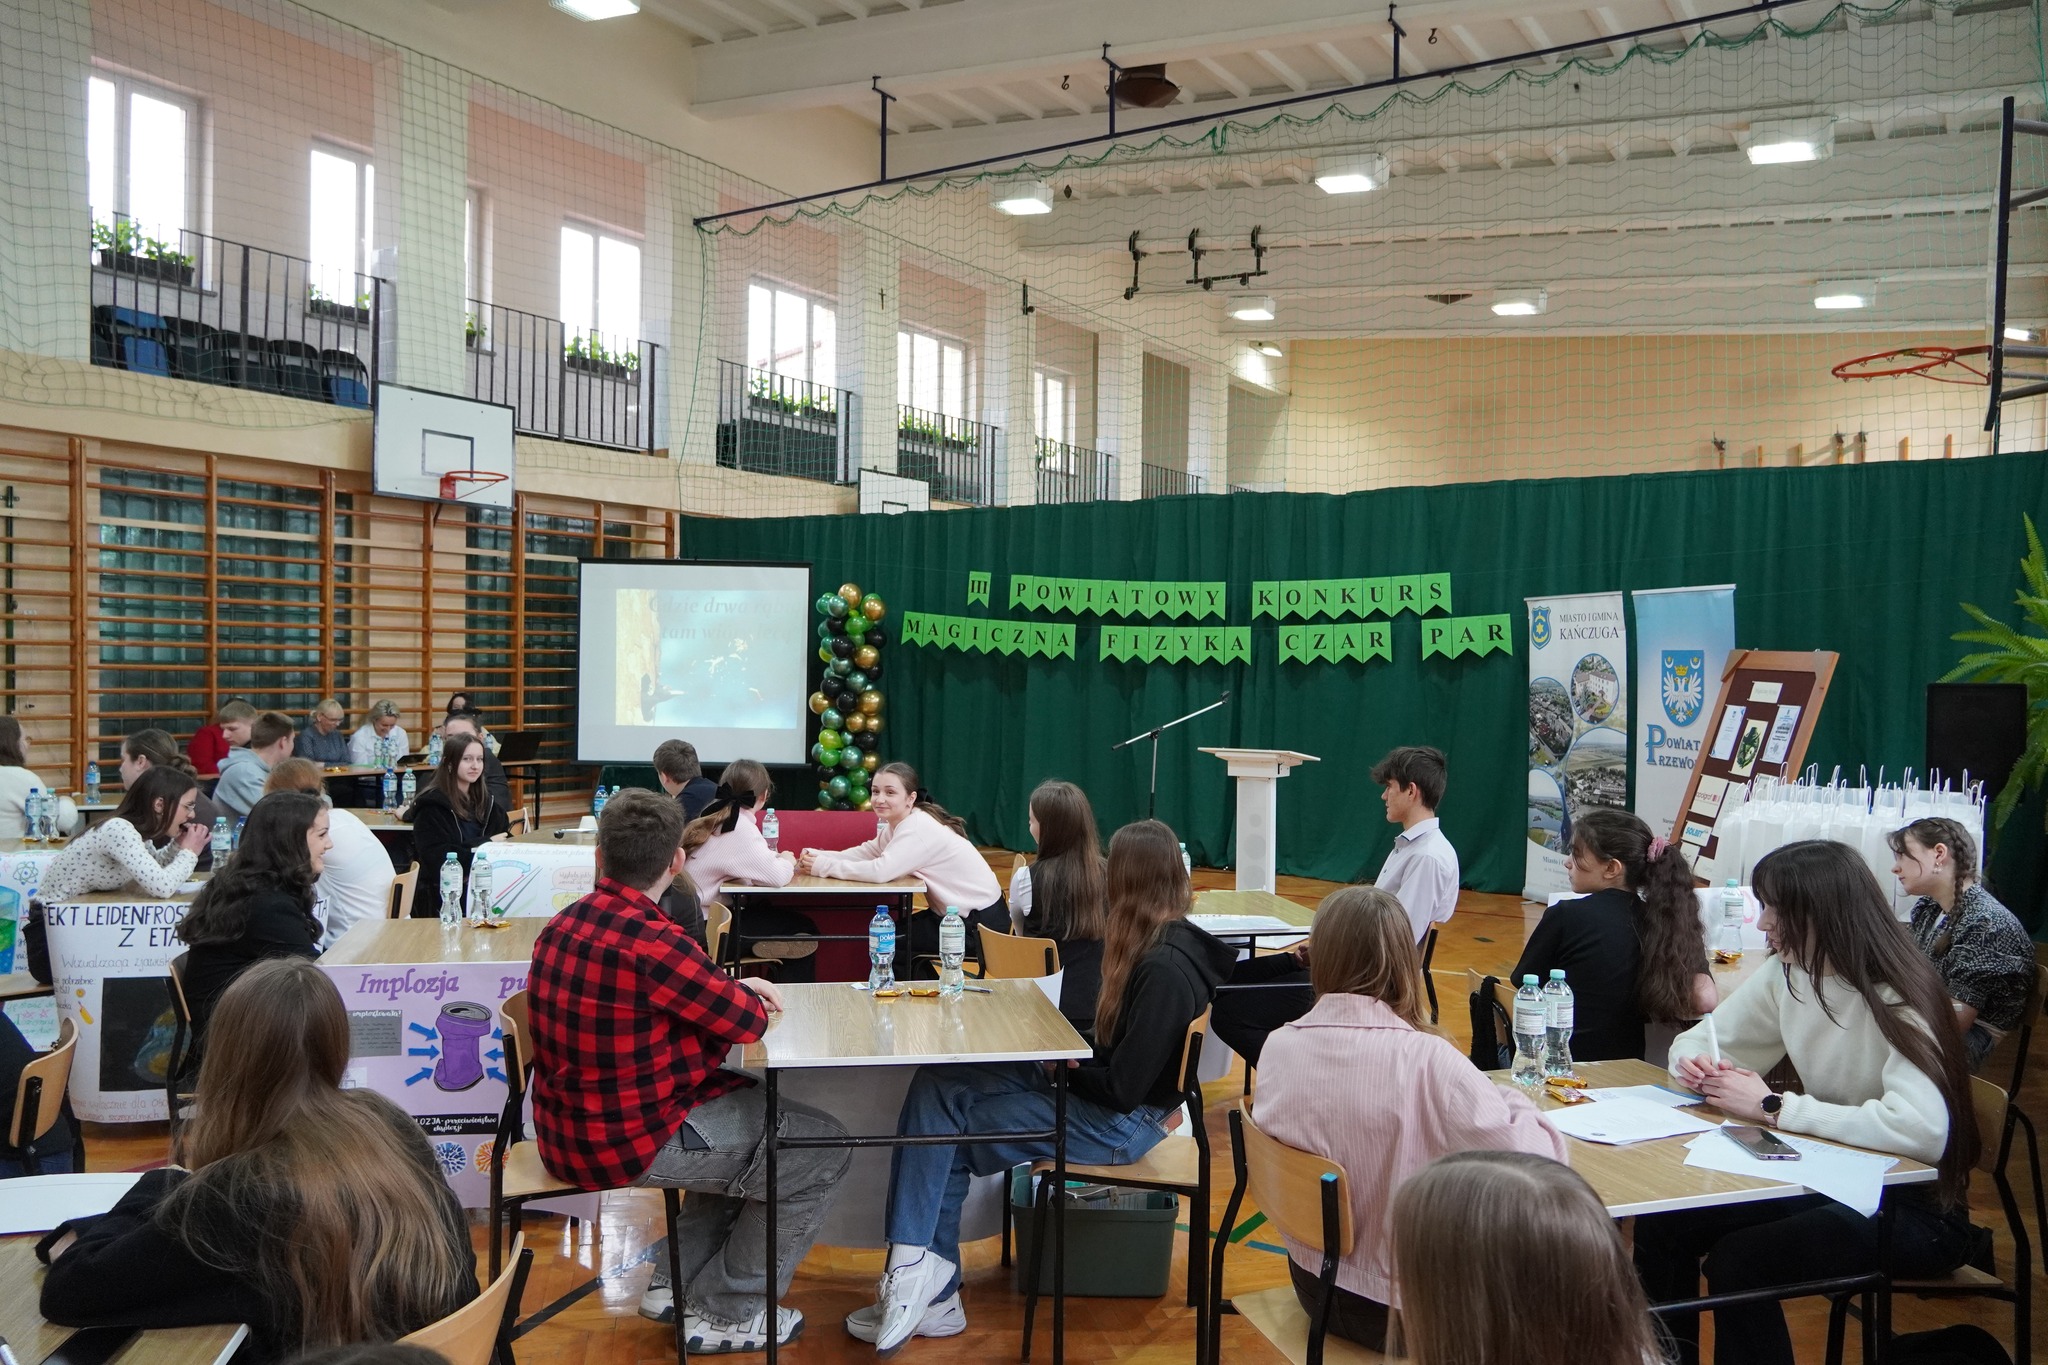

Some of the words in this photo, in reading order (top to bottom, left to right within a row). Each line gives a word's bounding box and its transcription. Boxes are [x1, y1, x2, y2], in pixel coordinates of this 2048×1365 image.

[970, 580, 988, 594] III
[1015, 582, 1220, 606] POWIATOWY
[1258, 582, 1442, 606] KONKURS
[704, 596, 747, 613] drwa
[1559, 613, 1587, 623] MIASTO
[1588, 613, 1591, 621] I
[1592, 611, 1619, 622] GMINA
[905, 619, 1070, 647] MAGICZNA
[1106, 633, 1244, 651] FIZYKA
[1284, 630, 1384, 650] CZAR
[1430, 623, 1505, 645] PAR
[1559, 624, 1620, 640] KAŃCZUGA
[85, 905, 191, 926] LEIDENFROS
[118, 927, 135, 948] Z
[149, 927, 187, 947] ETA
[356, 968, 460, 1001] Implozja
